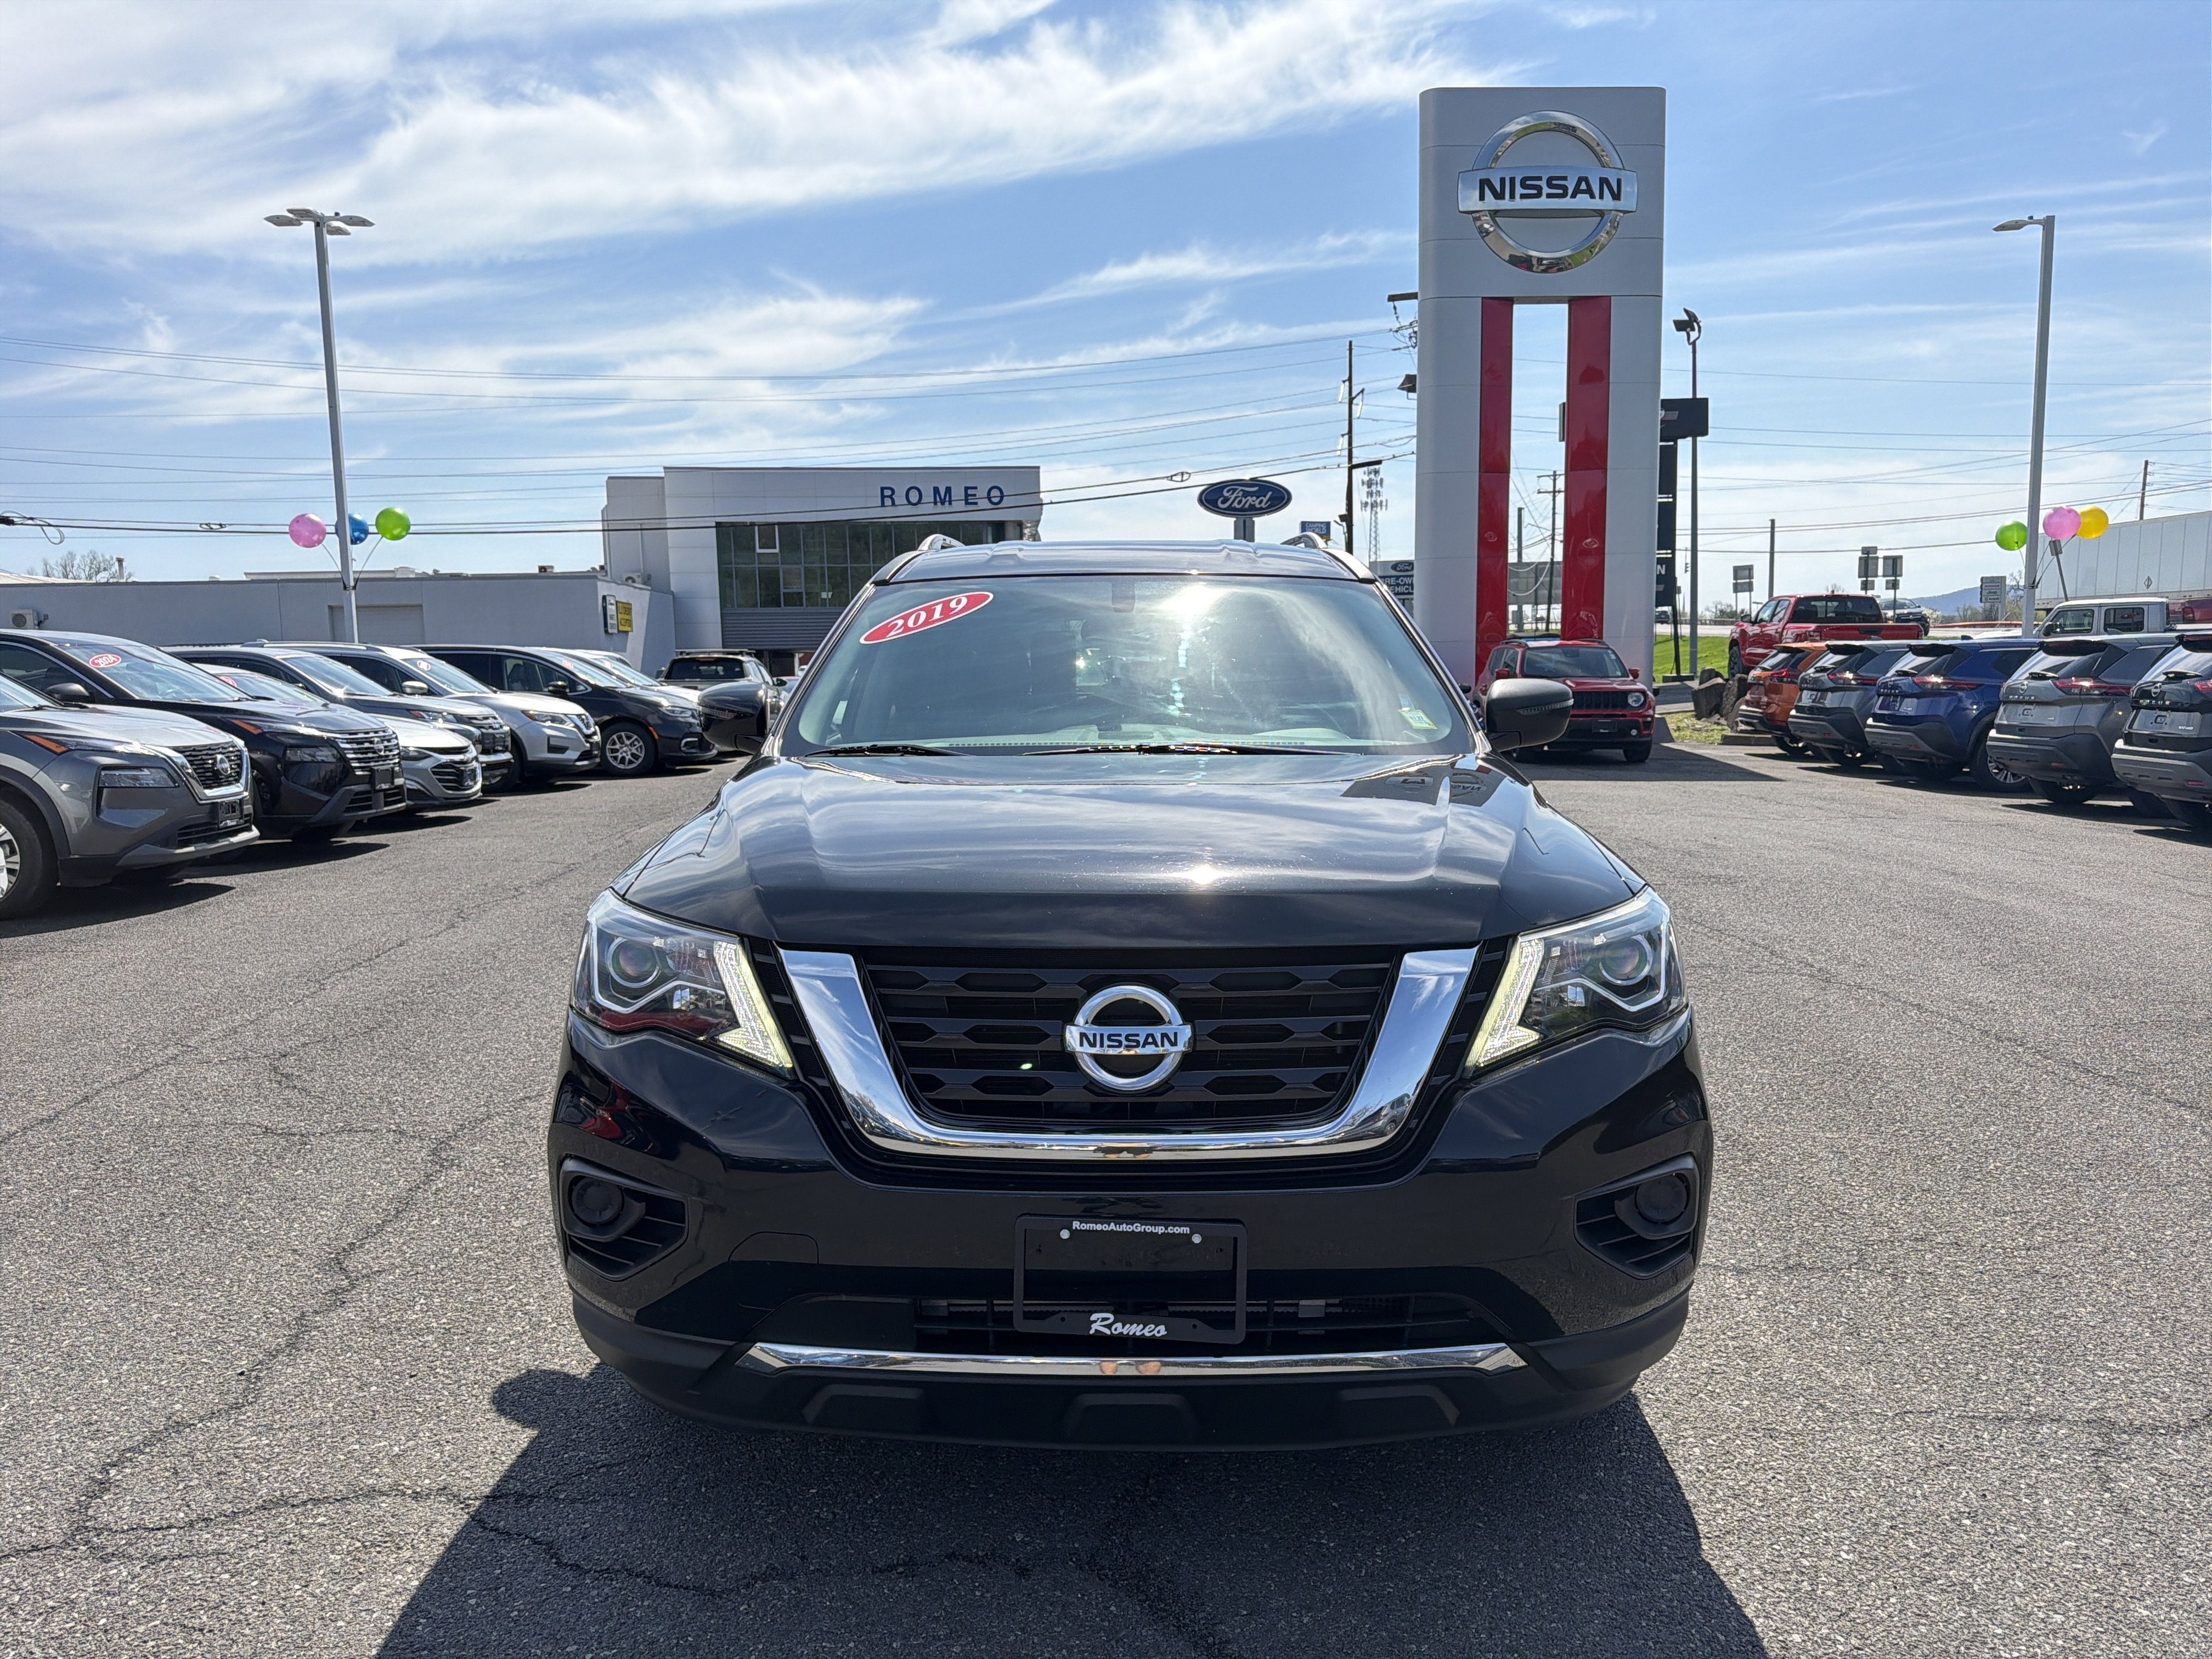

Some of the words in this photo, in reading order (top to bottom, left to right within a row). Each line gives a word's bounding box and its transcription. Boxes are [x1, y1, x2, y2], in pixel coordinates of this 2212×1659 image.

[1479, 176, 1622, 201] NISSAN
[880, 486, 1004, 506] ROMEO
[1217, 486, 1272, 508] Ford
[885, 596, 968, 638] 2019
[1079, 1031, 1178, 1048] NISSAN
[1073, 1221, 1190, 1234] RomeoAutoGroup.com
[1089, 1313, 1167, 1337] Romeo
